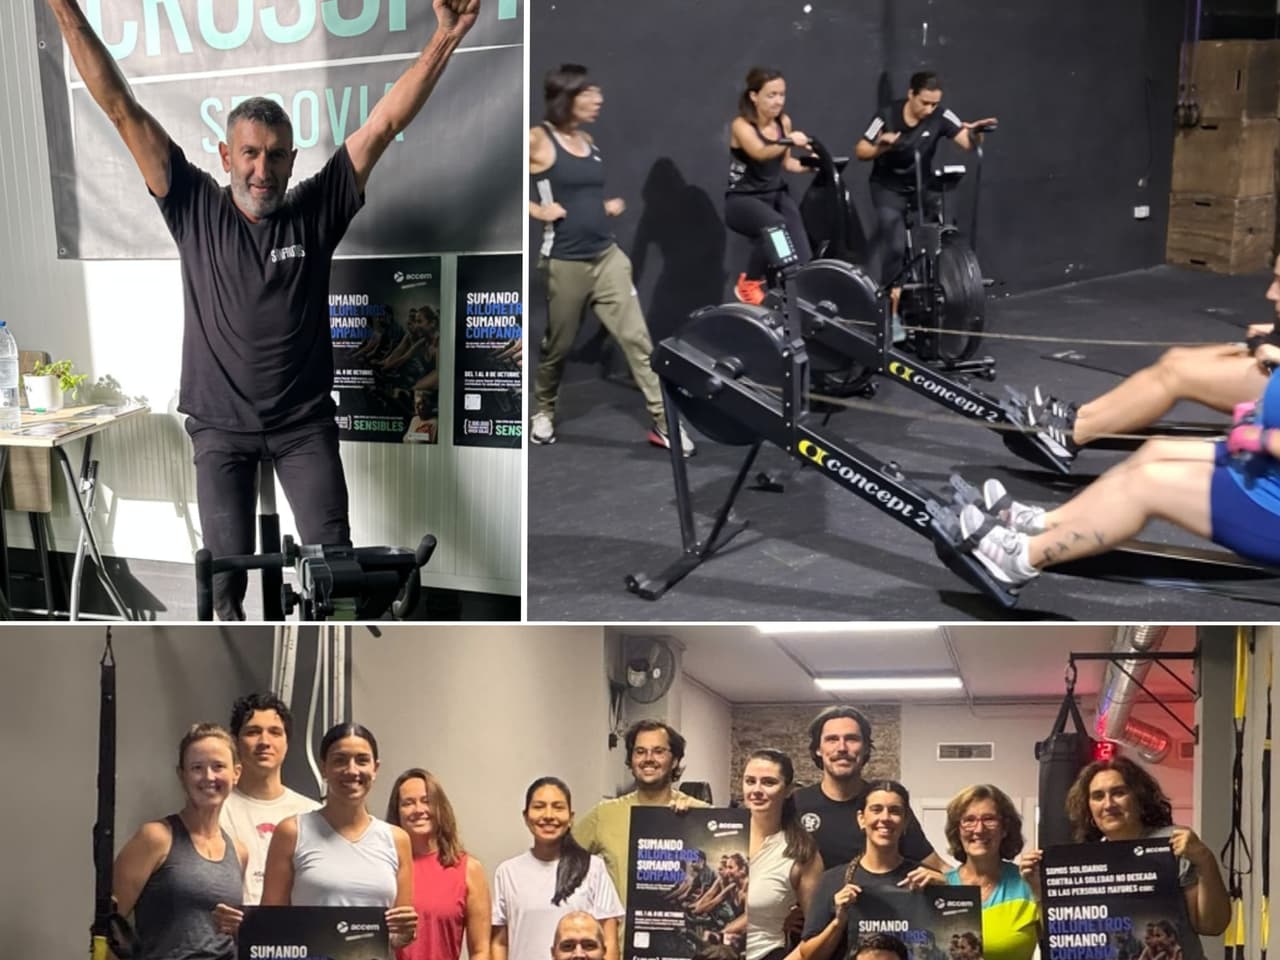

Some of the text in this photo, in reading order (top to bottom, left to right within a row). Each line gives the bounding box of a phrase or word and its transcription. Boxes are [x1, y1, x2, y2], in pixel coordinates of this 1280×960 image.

[466, 291, 519, 304] SUMANDO
[466, 316, 516, 328] SUMANDO
[913, 374, 999, 423] concept 2
[353, 419, 404, 432] SENSIBLES
[826, 458, 930, 527] concept 2
[637, 839, 684, 851] SUMANDO
[637, 860, 681, 872] SUMANDO
[1047, 905, 1108, 921] SUMANDO
[858, 920, 909, 933] SUMANDO
[1049, 932, 1107, 949] SUMANDO
[250, 945, 308, 959] SUMANDO
